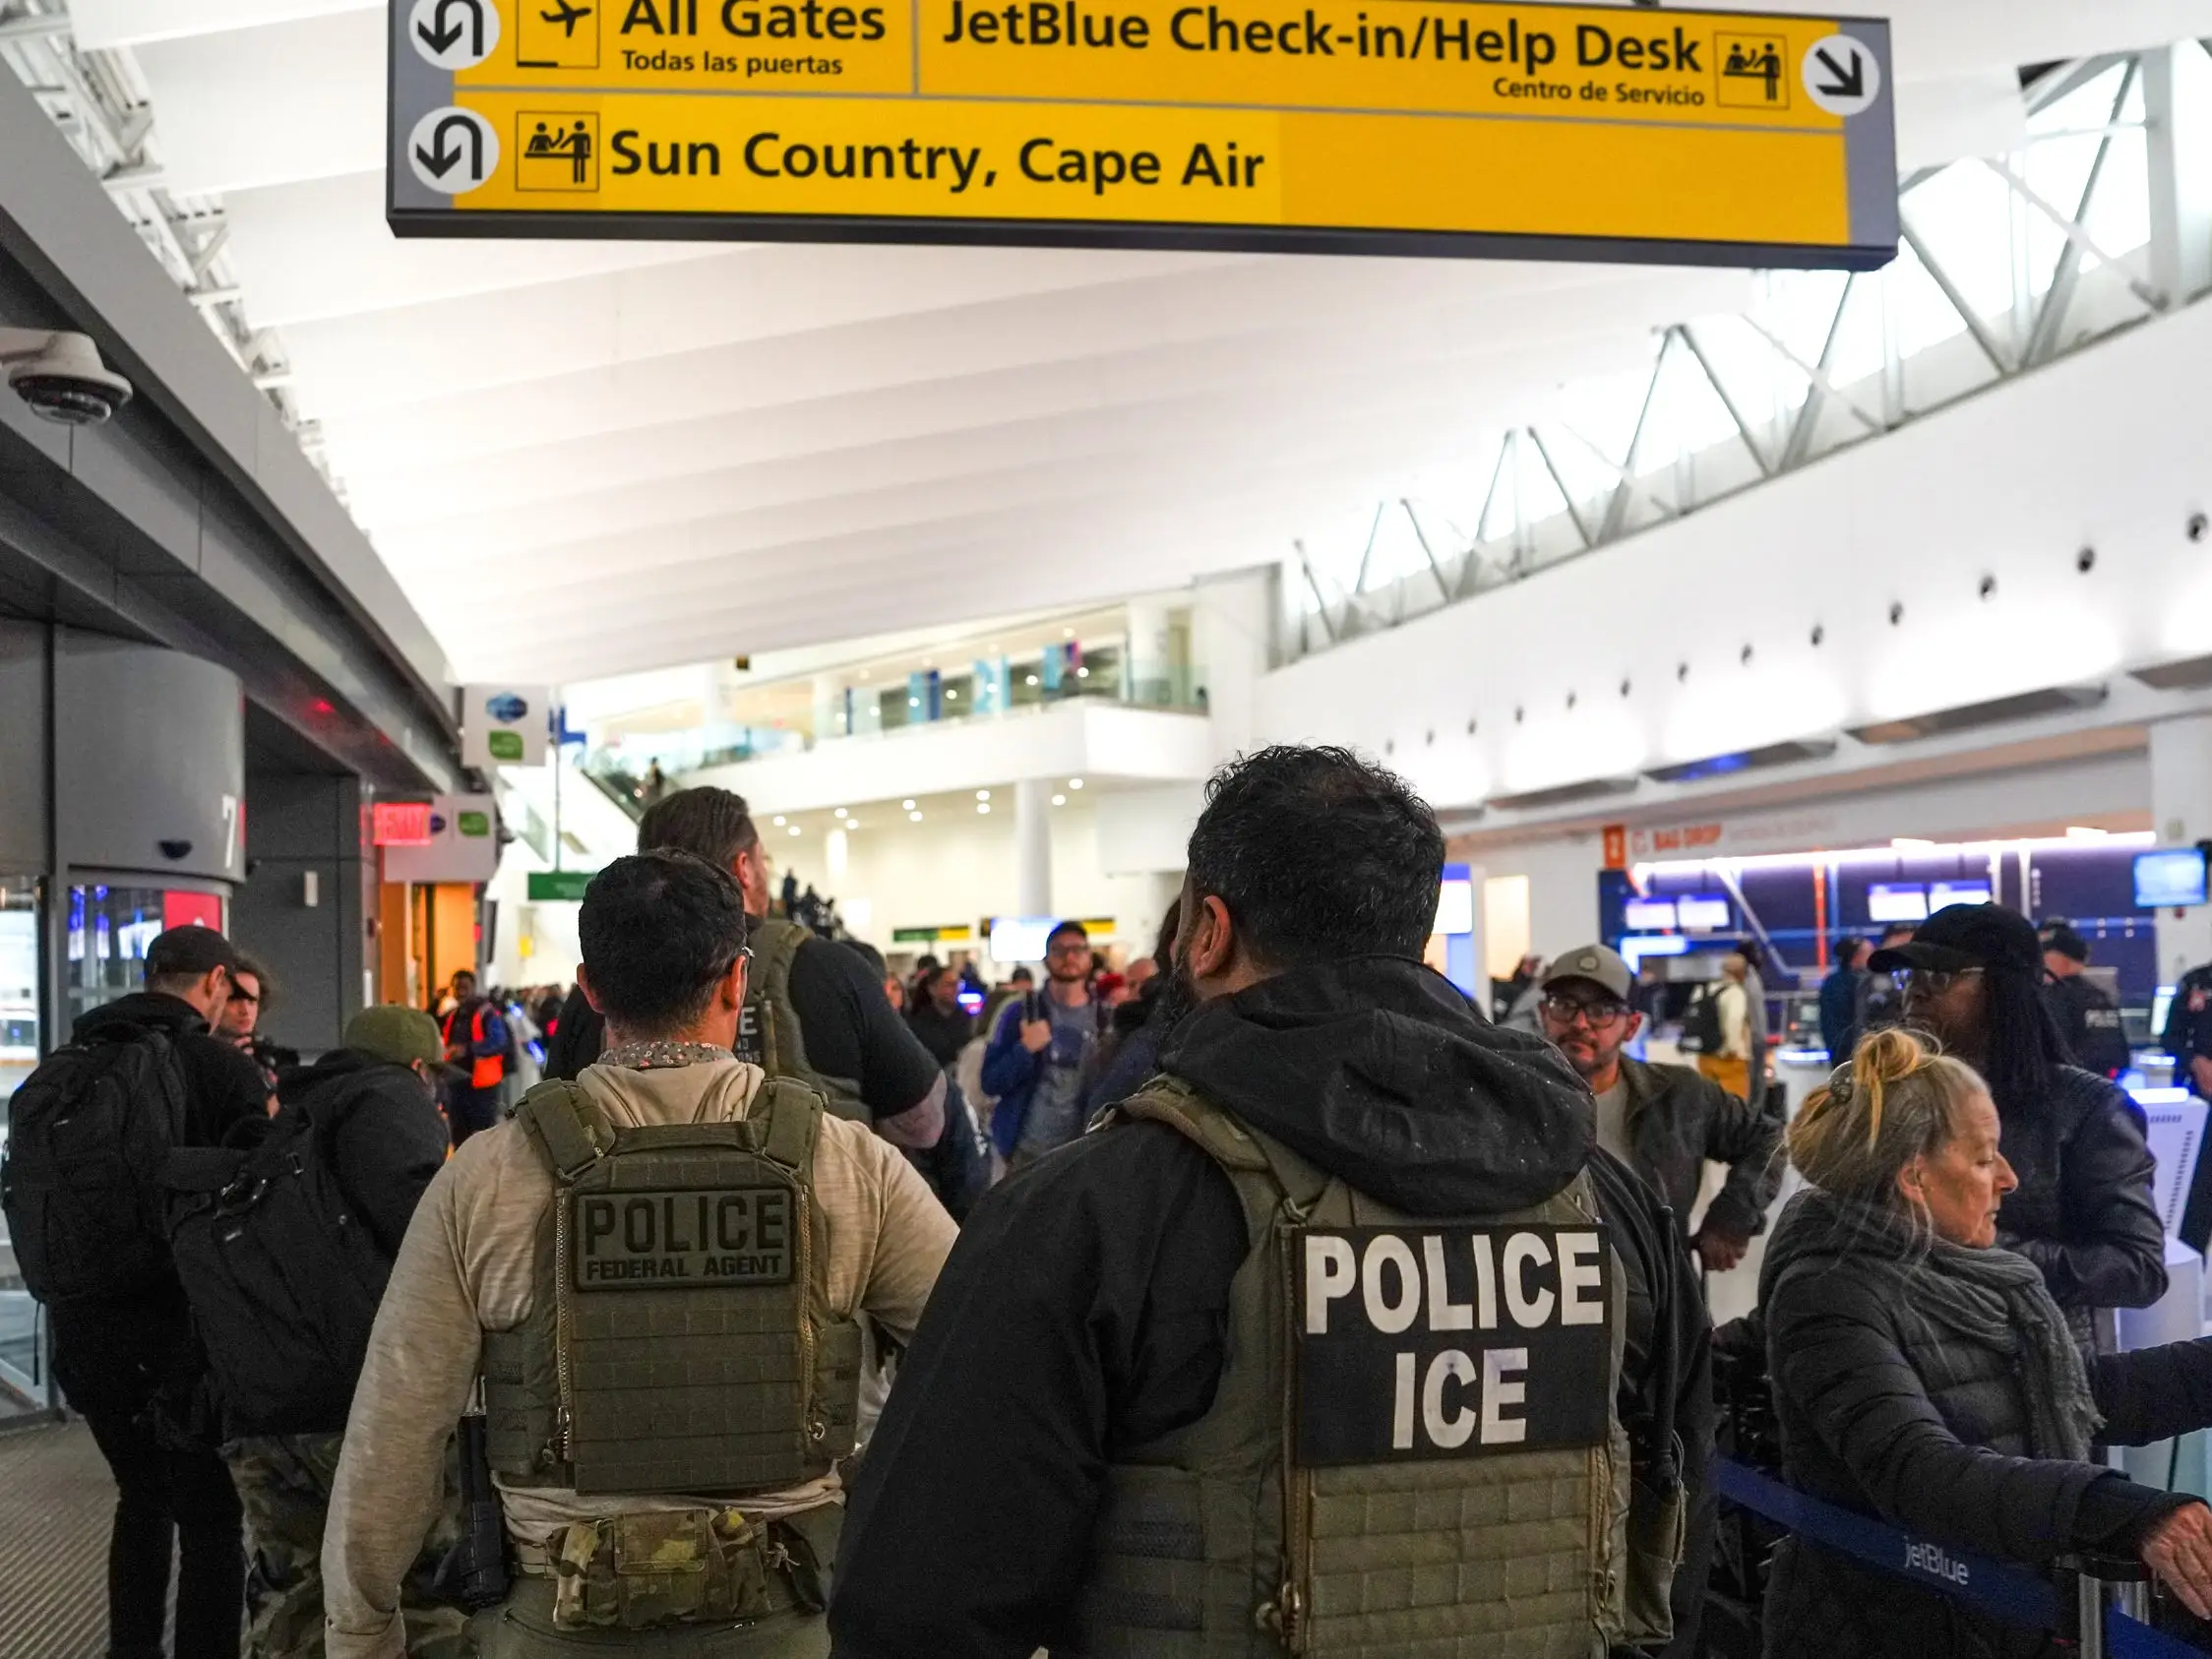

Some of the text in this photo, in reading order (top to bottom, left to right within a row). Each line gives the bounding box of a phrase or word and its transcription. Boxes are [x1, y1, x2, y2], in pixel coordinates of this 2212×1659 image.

[620, 0, 886, 41] All Gates
[943, 0, 1703, 77] JetBlue Check-in/Help Desk
[621, 49, 843, 78] Todas las puertas
[1493, 77, 1705, 107] Centro de Servicio
[611, 129, 1265, 197] Sun Country, Cape Air
[584, 1194, 785, 1257] POLICE
[585, 1255, 783, 1280] FEDERAL AGENT
[1305, 1231, 1605, 1334] POLICE
[1392, 1346, 1529, 1449] ICE
[1903, 1535, 1970, 1586] jetBlue
